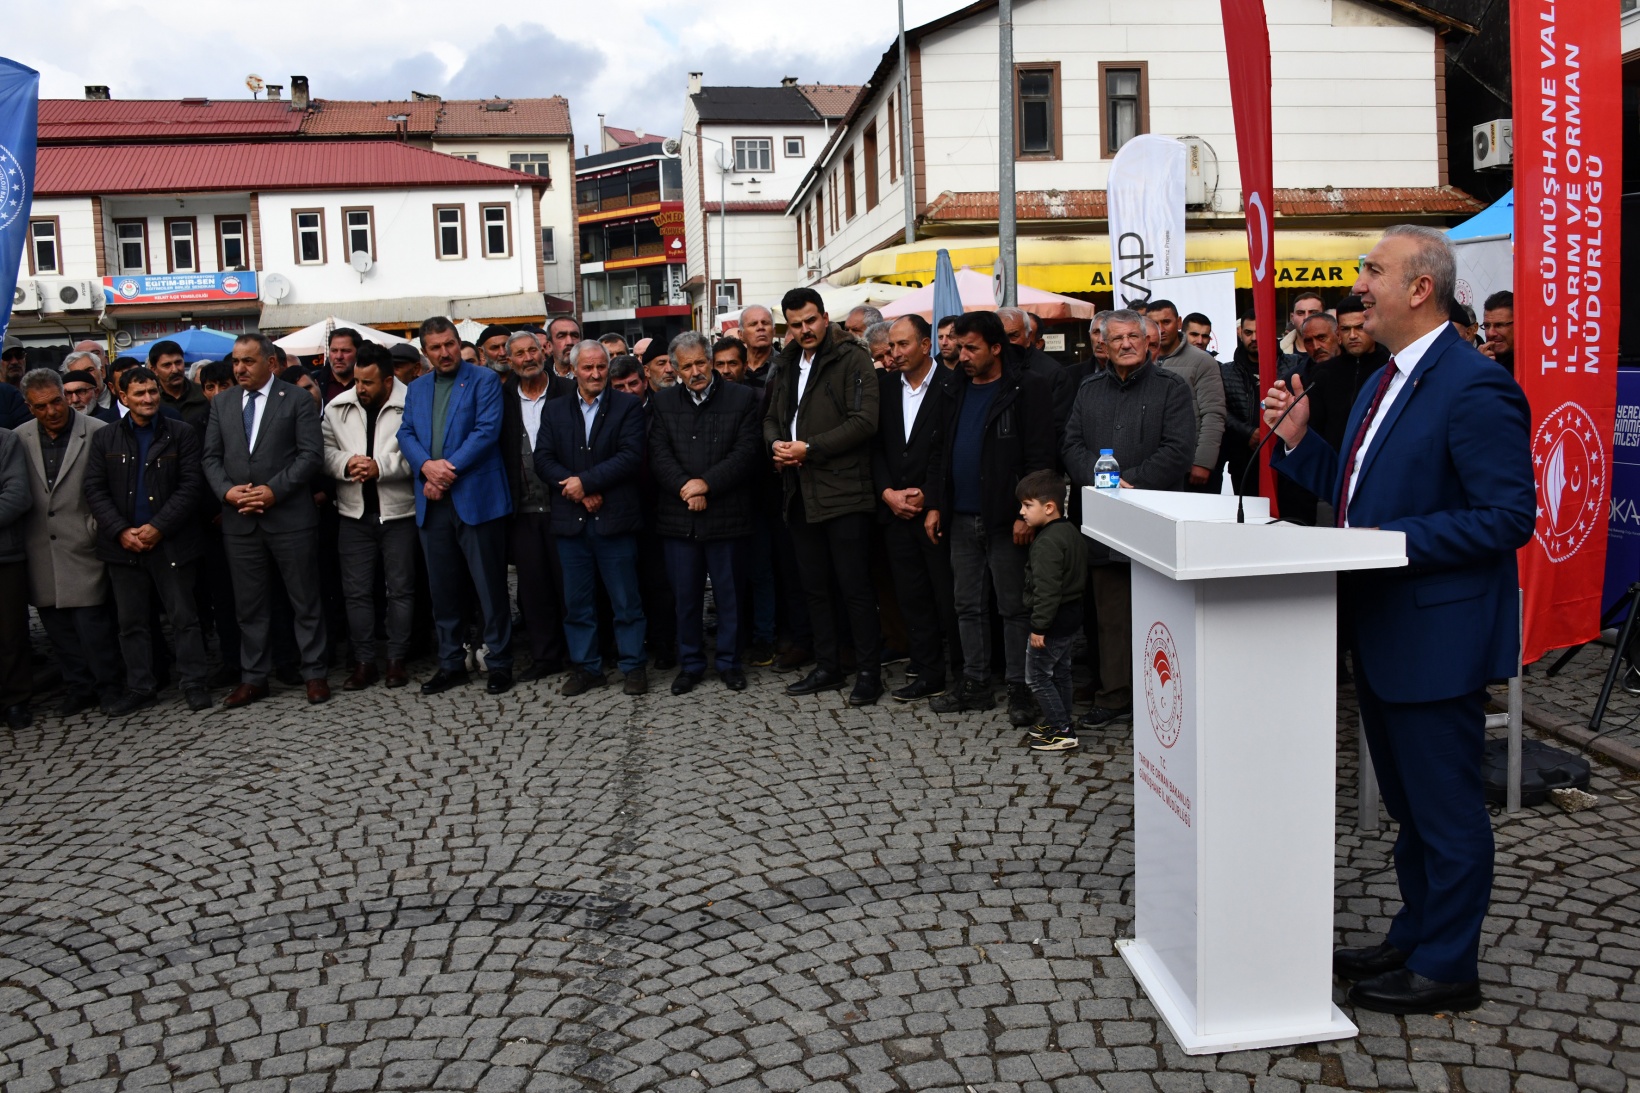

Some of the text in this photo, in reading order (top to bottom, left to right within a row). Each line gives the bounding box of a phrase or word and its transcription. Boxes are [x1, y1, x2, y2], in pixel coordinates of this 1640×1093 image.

[1540, 0, 1560, 375] T.C. GÜMÜŞHANE VAL
[1565, 43, 1582, 373] İL TARIM VE ORMAN
[654, 211, 685, 227] HANED
[1582, 154, 1603, 374] MÜDÜRLÜĞÜ
[1274, 266, 1344, 282] AZAR
[141, 321, 167, 337] ŞEN
[1616, 405, 1640, 419] YERE
[1614, 418, 1640, 433] KINMA
[1612, 432, 1640, 447] MLESİ
[1139, 752, 1191, 811] TARIM VE ORMAN BAKANLIĞI
[1139, 767, 1161, 798] GÜMÜŞHANE
[1165, 794, 1191, 828] MÜDÜRLÜĞÜ
